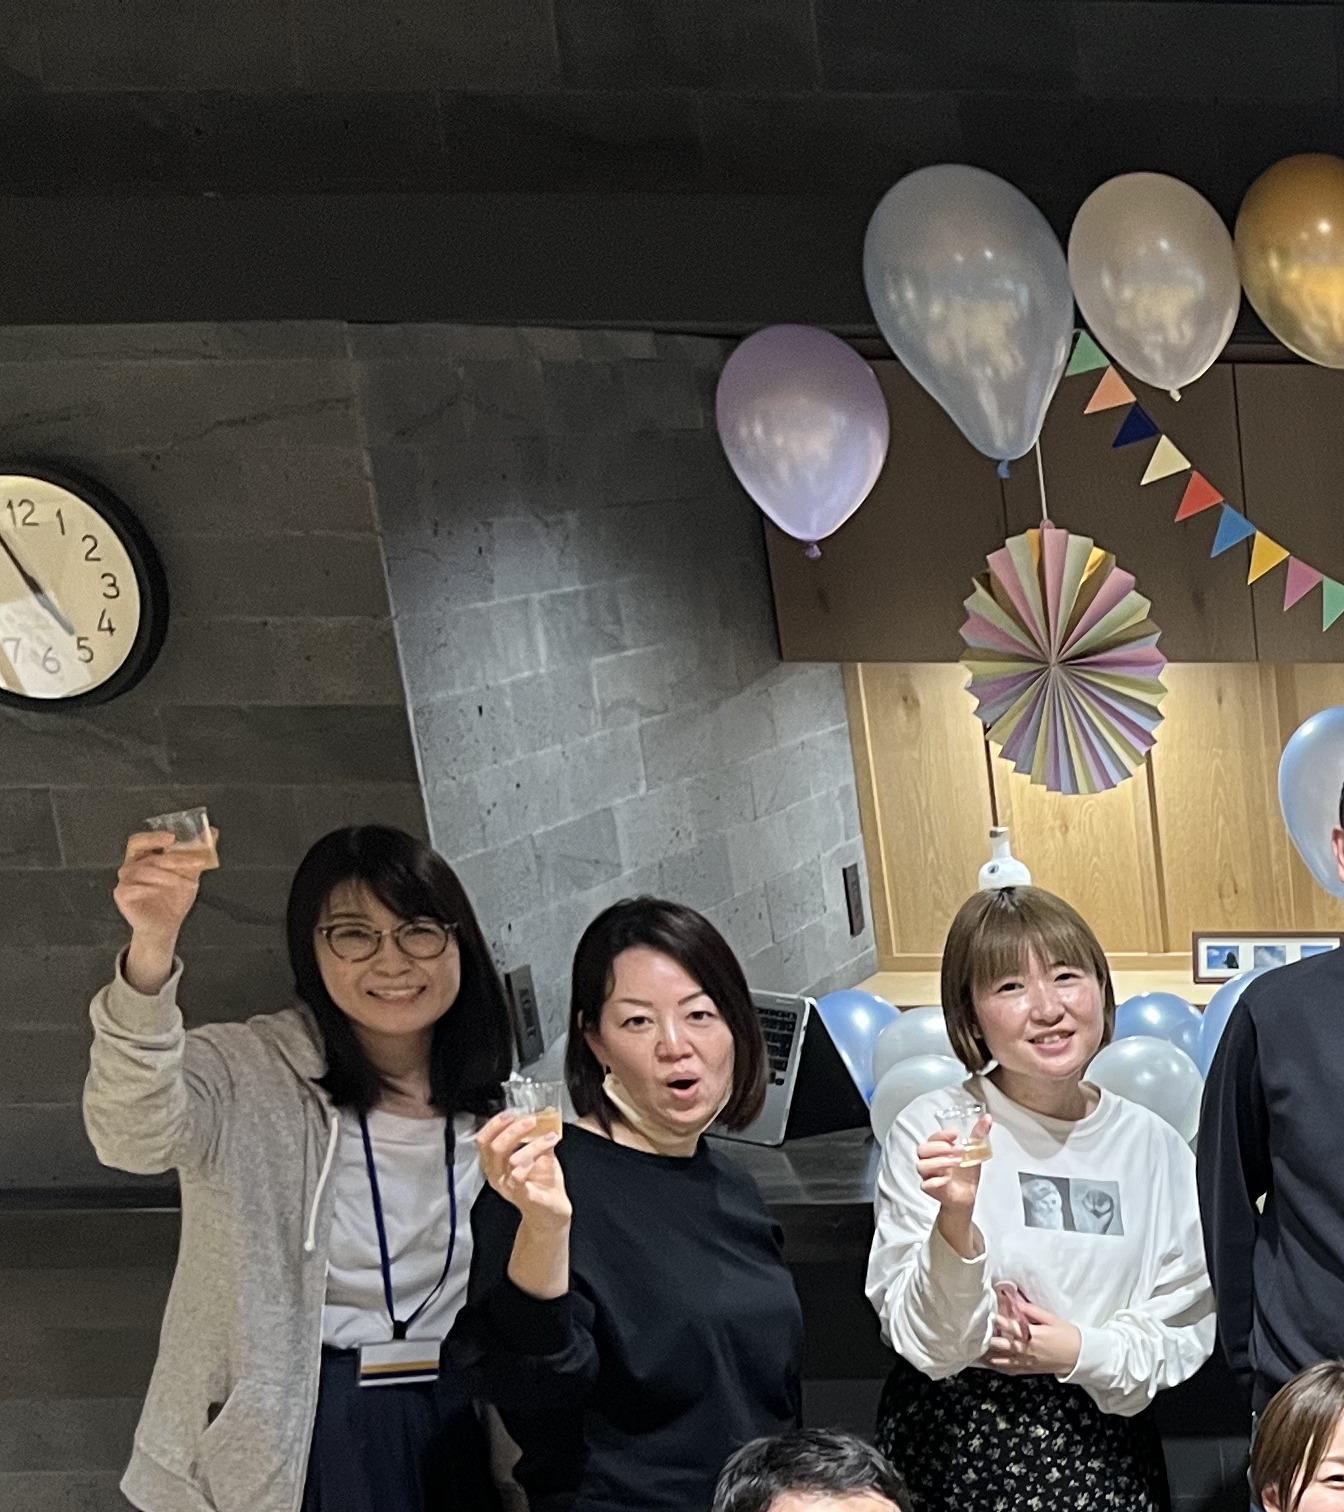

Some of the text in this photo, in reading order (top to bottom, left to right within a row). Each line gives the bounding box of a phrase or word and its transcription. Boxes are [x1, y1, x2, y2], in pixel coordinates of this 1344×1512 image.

[6, 498, 40, 527] 12
[55, 508, 66, 536] 1
[82, 534, 102, 562] 2
[100, 572, 120, 600] 3
[96, 608, 117, 637] 4
[2, 637, 21, 665] 7
[41, 646, 62, 675] 6
[75, 636, 95, 664] 5
